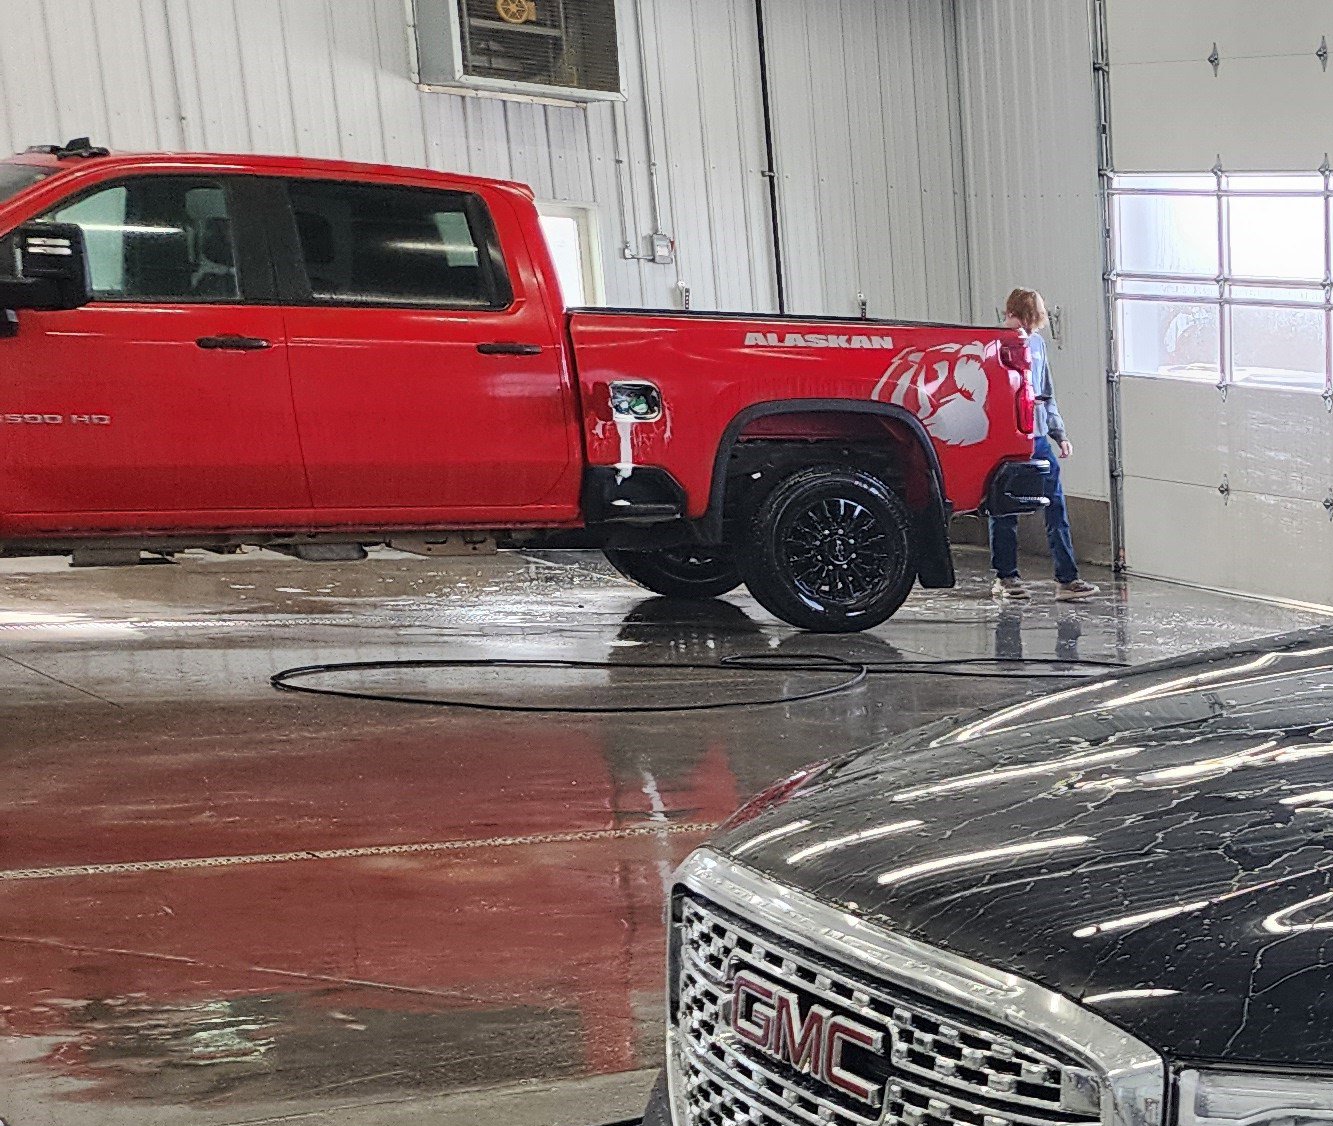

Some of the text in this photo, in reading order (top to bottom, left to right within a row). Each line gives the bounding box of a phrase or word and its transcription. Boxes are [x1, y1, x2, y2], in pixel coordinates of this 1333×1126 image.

[744, 332, 894, 349] ALASKAN
[0, 414, 111, 424] 500 HD
[731, 970, 884, 1108] GMC
